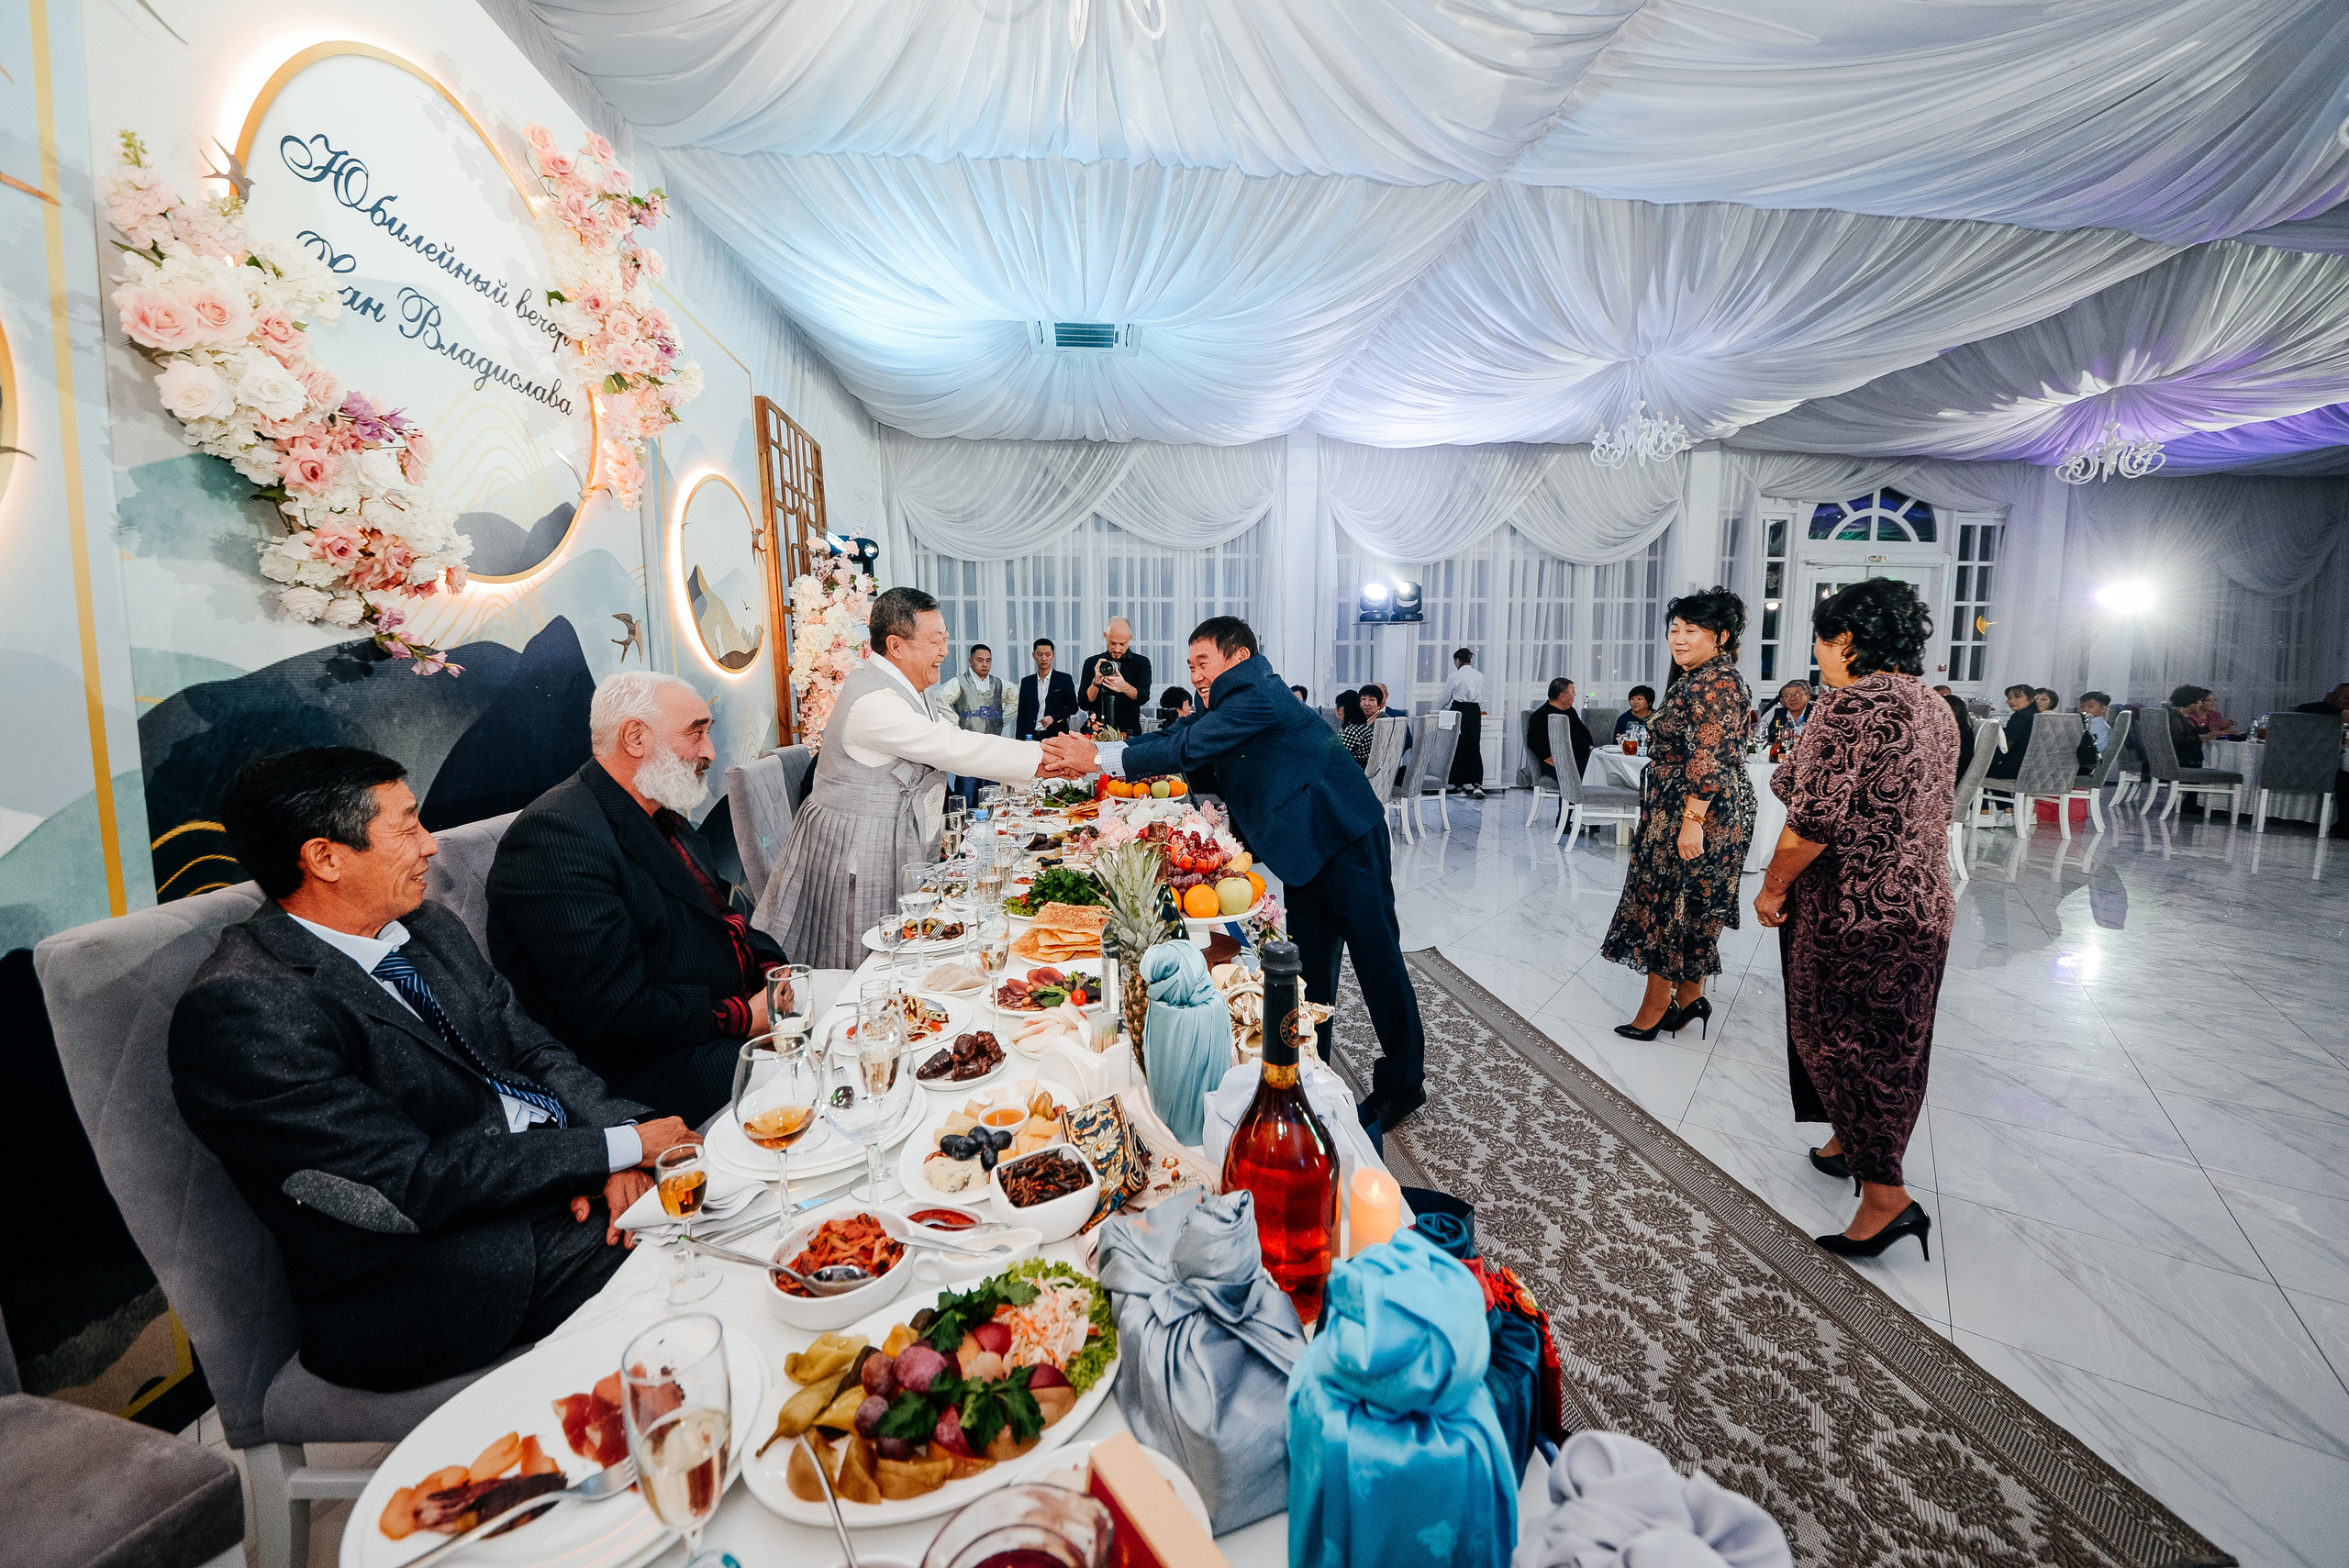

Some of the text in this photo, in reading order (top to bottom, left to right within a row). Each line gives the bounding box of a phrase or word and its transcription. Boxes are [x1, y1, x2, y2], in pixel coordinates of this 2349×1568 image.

[280, 134, 571, 353] Юбилейный вечер
[396, 286, 573, 416] Владислава
